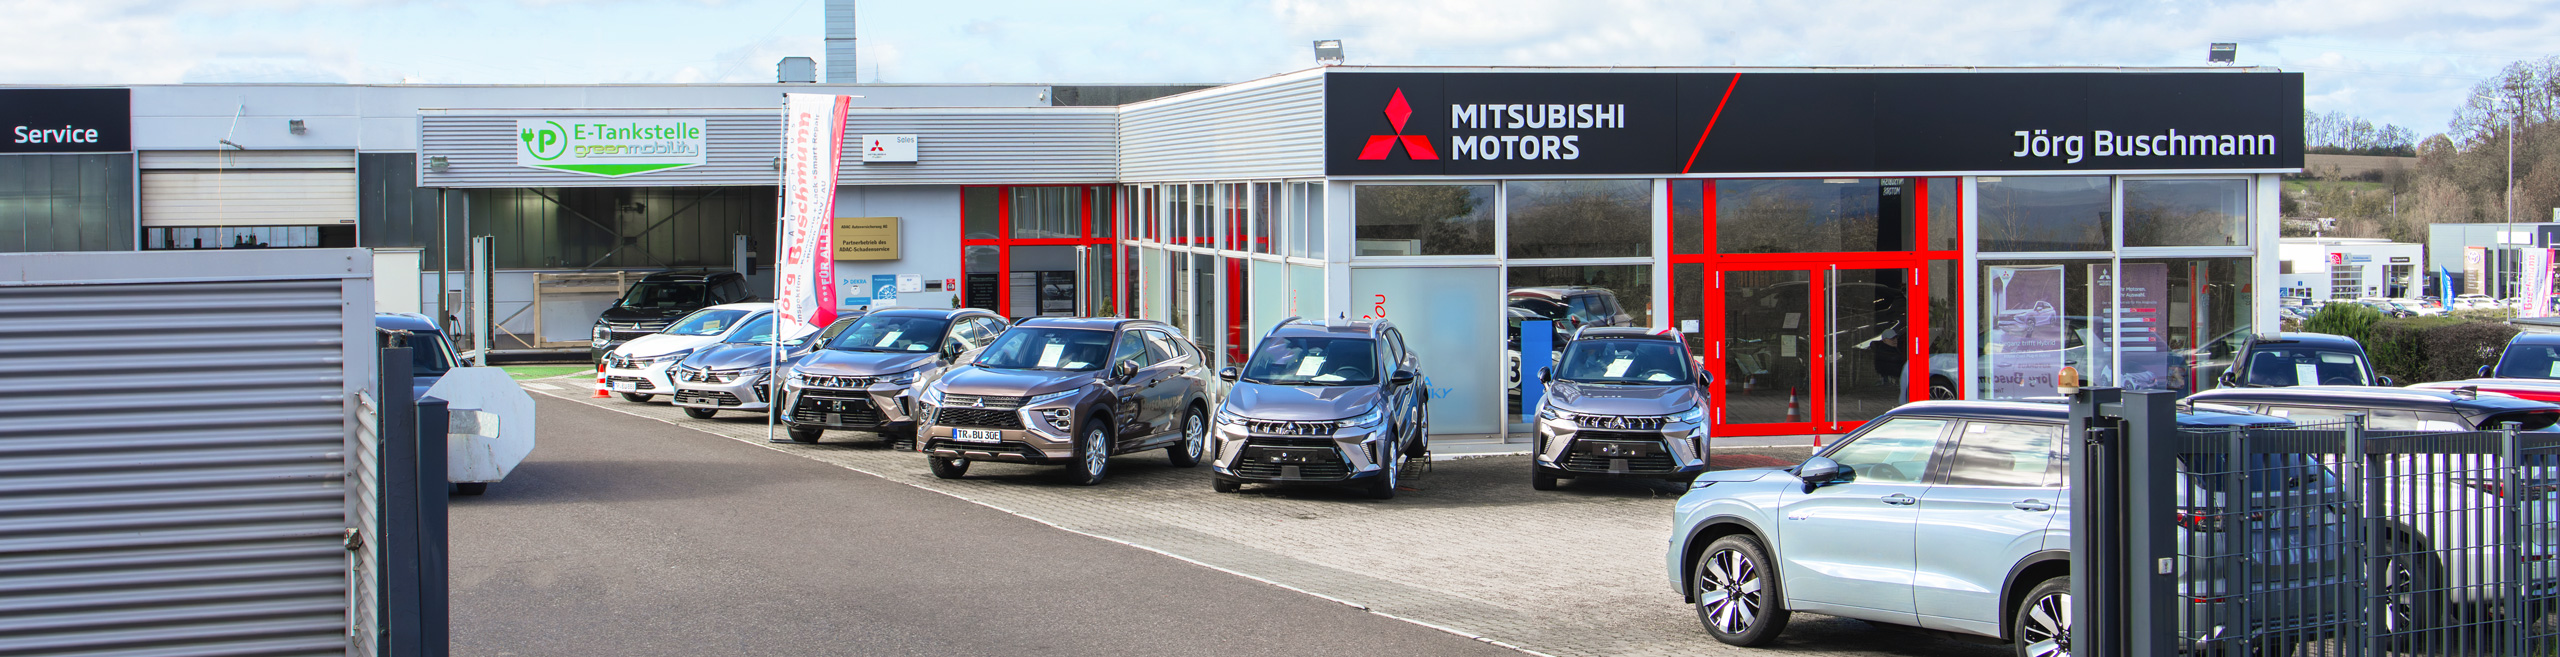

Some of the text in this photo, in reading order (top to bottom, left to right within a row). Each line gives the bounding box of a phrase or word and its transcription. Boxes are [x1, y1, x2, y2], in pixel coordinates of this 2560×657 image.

[812, 114, 820, 144] Repair
[1452, 103, 1625, 129] MITSUBISHI
[14, 125, 98, 143] Service
[574, 122, 700, 140] E-Tankstelle
[897, 136, 915, 144] Sales
[574, 141, 699, 158] greenmobility
[1452, 135, 1580, 161] MOTORS
[2013, 129, 2275, 164] Jörg Buschmann
[780, 112, 811, 326] Jörg Buschmann
[820, 229, 829, 258] ALLE
[2523, 254, 2536, 311] Buschmann
[1375, 294, 1386, 319] OU
[958, 430, 1000, 440] TR BU 30E
